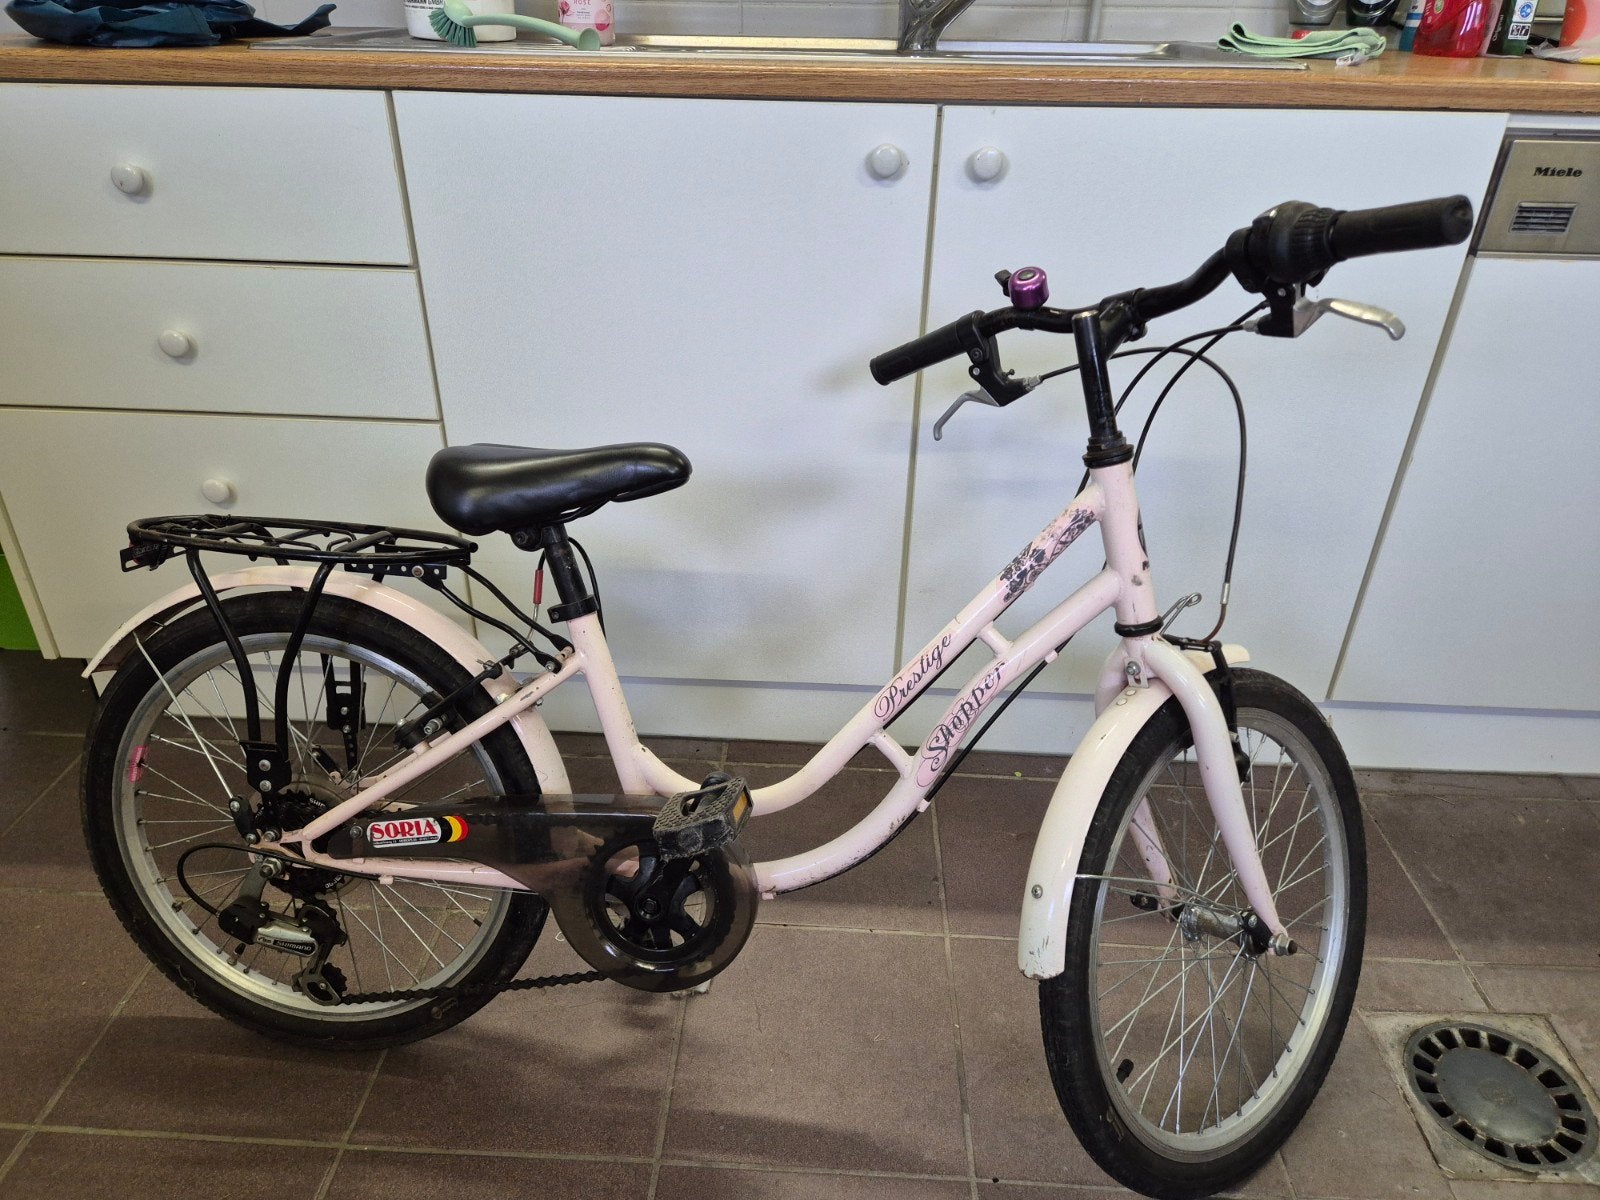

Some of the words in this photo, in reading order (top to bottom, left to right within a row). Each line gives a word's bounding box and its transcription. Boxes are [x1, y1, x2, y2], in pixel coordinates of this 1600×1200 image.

[1533, 166, 1583, 177] Miele
[874, 633, 952, 720] Prestige
[370, 819, 438, 840] SORIA
